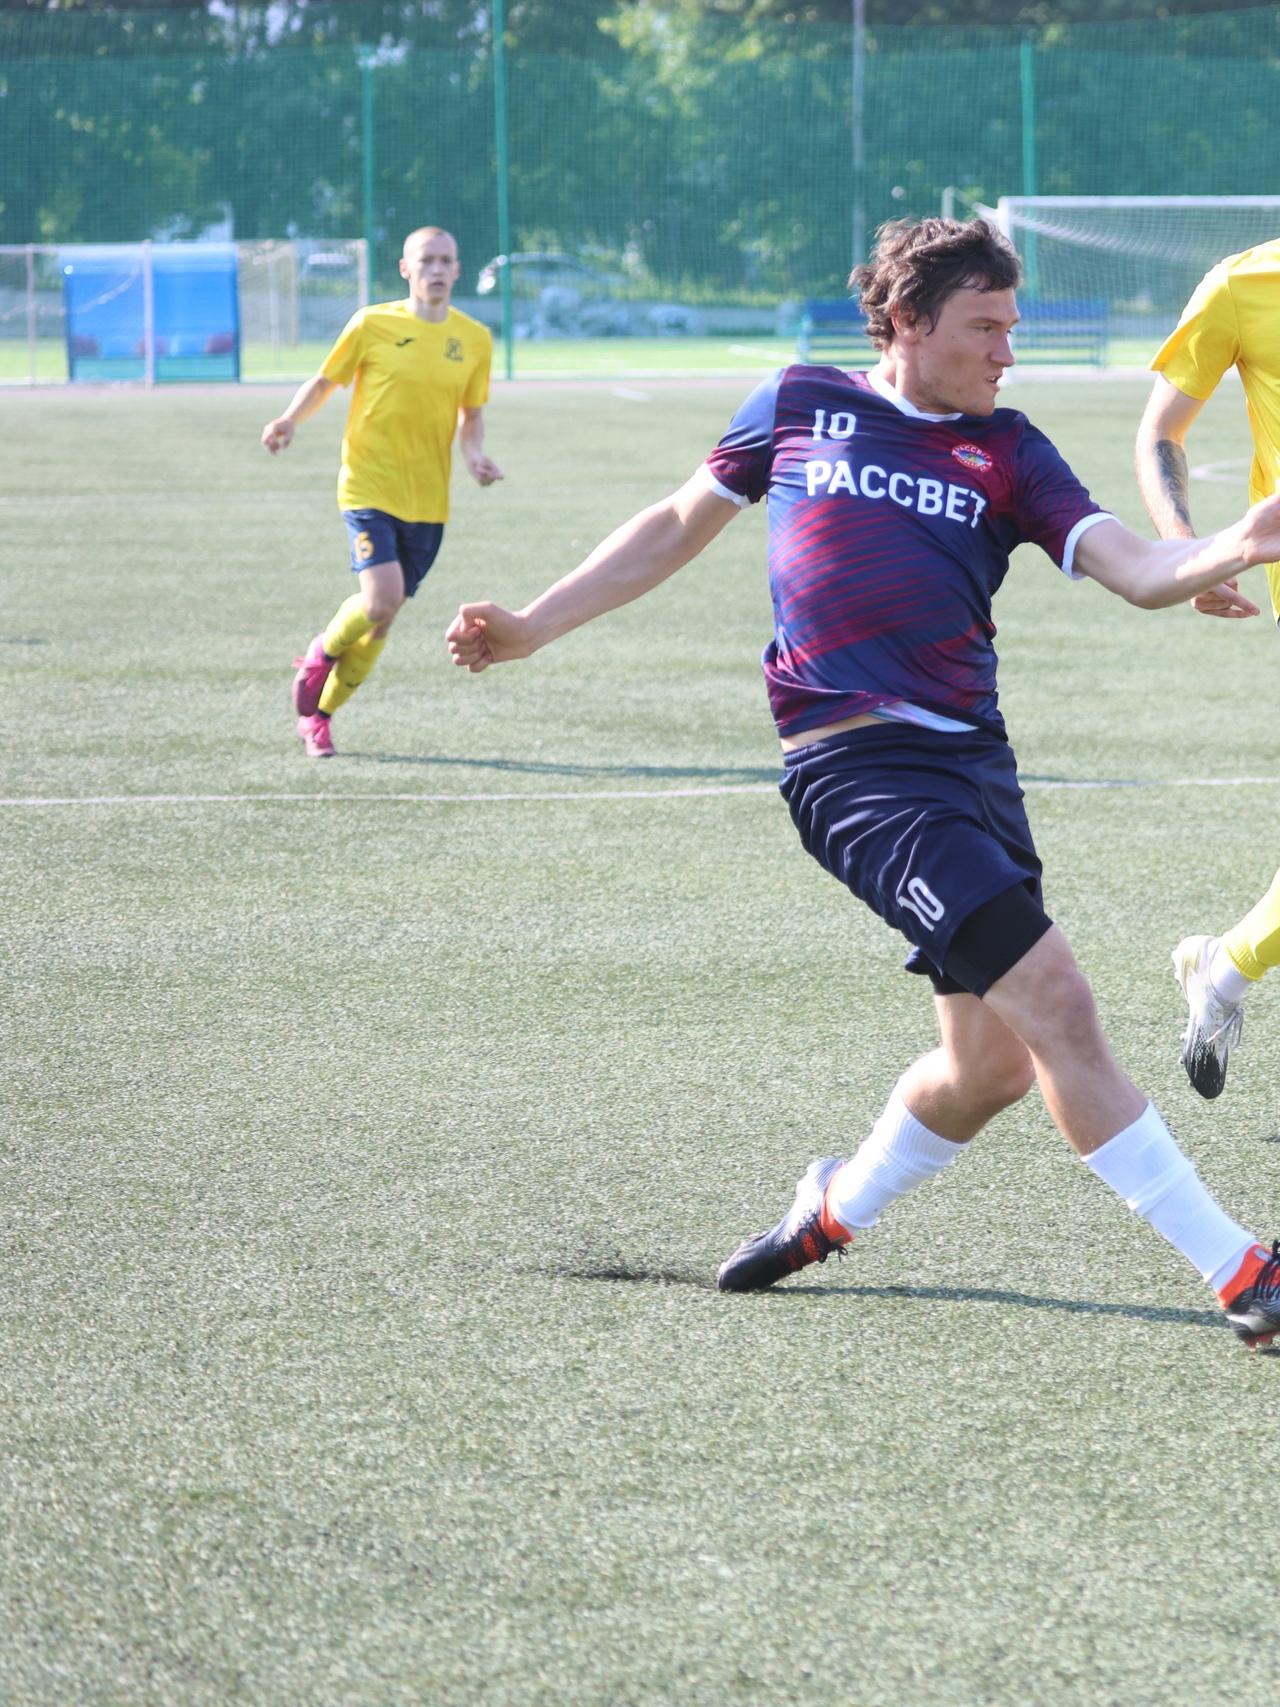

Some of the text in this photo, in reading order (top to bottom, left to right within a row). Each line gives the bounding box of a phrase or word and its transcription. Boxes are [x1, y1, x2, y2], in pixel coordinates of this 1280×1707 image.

[812, 409, 857, 441] 10
[804, 461, 987, 529] РАССВЕТ
[897, 877, 945, 932] 10
